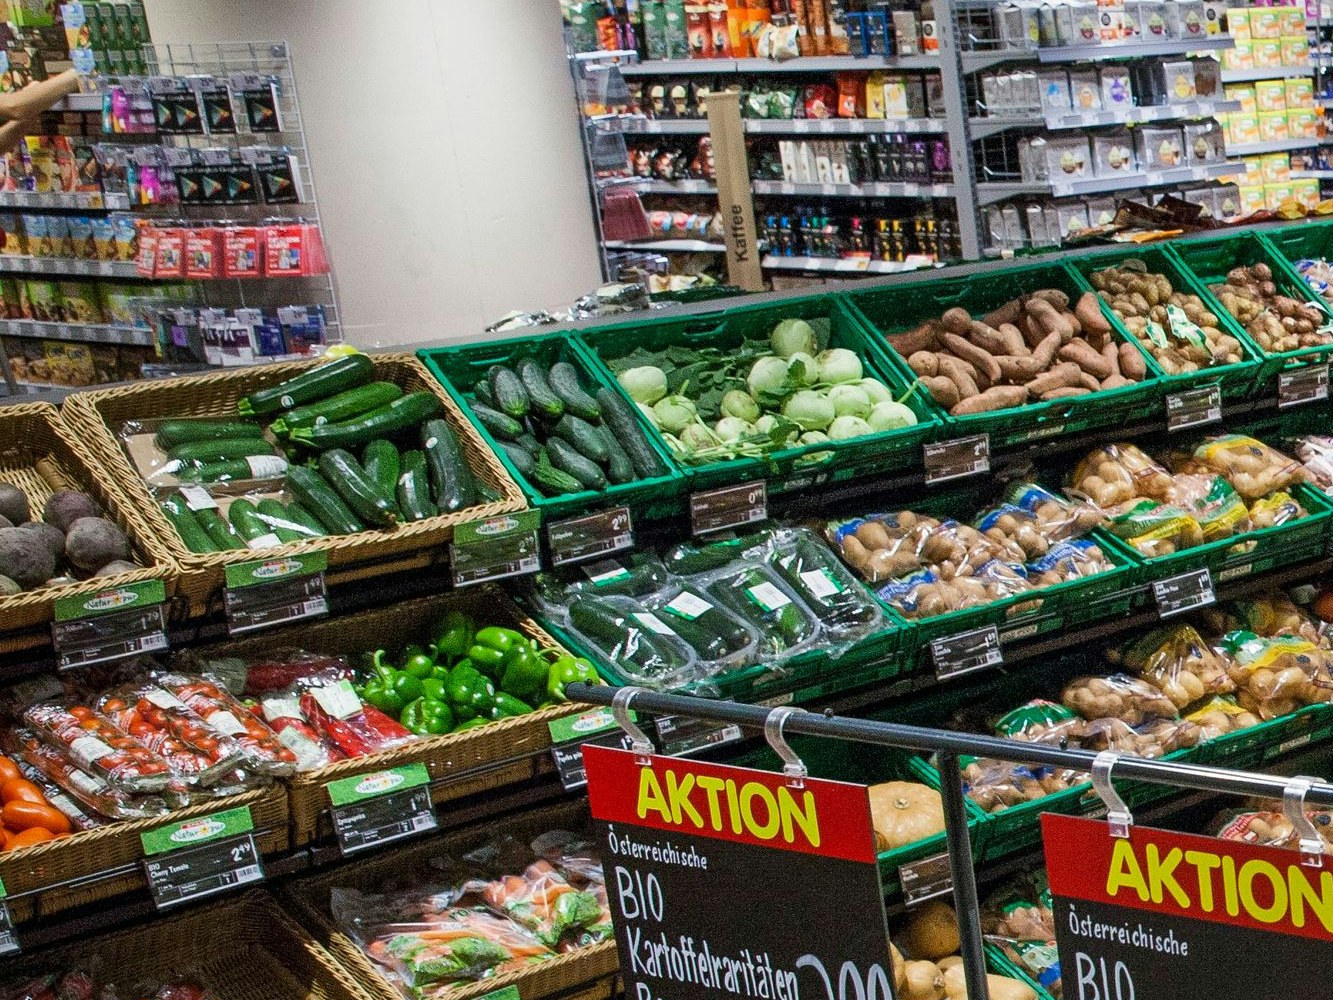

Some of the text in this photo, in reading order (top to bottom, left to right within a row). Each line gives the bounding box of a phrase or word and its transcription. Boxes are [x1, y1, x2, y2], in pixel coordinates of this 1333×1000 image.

[733, 204, 748, 262] Kaffee
[636, 766, 821, 848] AKTION
[148, 863, 160, 872] BIO
[607, 824, 708, 871] Österreichische
[615, 866, 664, 922] BIO
[1068, 904, 1189, 957] Österreichische
